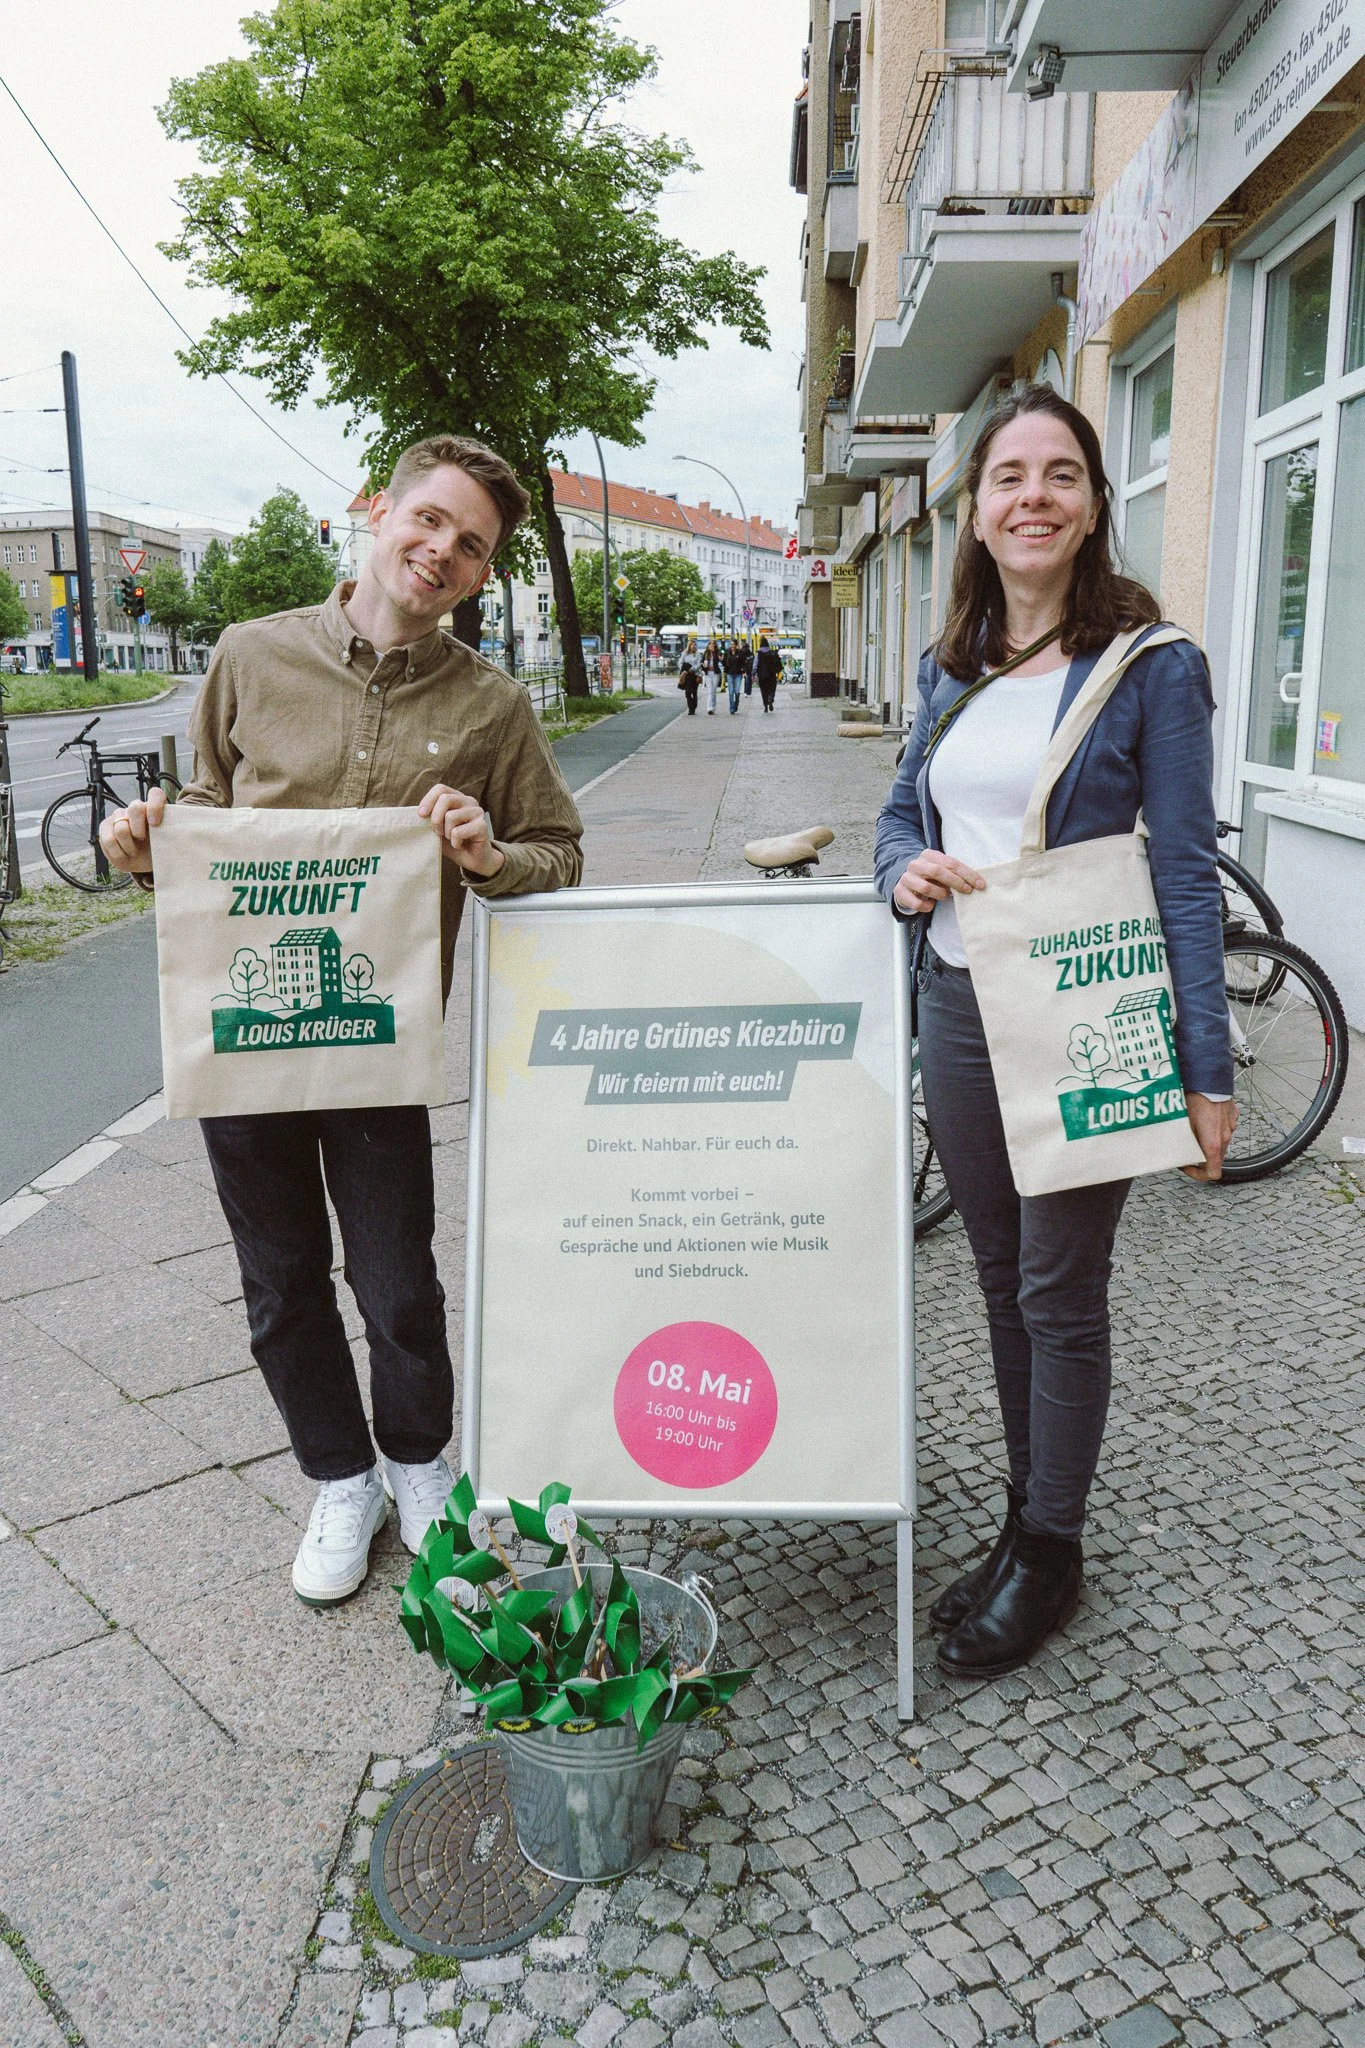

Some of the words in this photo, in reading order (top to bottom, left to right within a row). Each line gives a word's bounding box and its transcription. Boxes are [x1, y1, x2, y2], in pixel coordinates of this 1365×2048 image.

[1216, 0, 1282, 84] Steuerberate
[1234, 109, 1247, 137] fon
[1248, 50, 1292, 118] 45027553
[1299, 26, 1316, 61] fax
[1245, 24, 1351, 157] www.stb-reinhardt.de
[209, 861, 292, 881] ZUHAUSE
[296, 856, 381, 878] BRAUCHT
[228, 881, 367, 917] ZUKUNFT
[1029, 924, 1113, 958] ZUHAUSE
[1119, 917, 1162, 940] BRAU
[236, 1021, 294, 1046] LOUIS
[297, 1015, 377, 1042] KRÜGER
[550, 1024, 567, 1052] 4
[571, 1022, 639, 1051] Jahre
[645, 1020, 730, 1050] Grünes
[736, 1018, 846, 1047] Kiezbüro
[598, 1073, 628, 1094] Wir
[633, 1071, 689, 1093] feiern
[694, 1071, 725, 1092] mit
[729, 1070, 783, 1091] euch!
[1087, 1096, 1149, 1130] LOUIS
[587, 1138, 637, 1153] Direkt.
[642, 1137, 701, 1152] Nahbar.
[706, 1137, 731, 1151] Für
[734, 1137, 771, 1150] euch
[776, 1136, 799, 1150] da.
[631, 1188, 686, 1203] Kommt
[691, 1187, 739, 1201] vorbei
[562, 1214, 587, 1229] auf
[592, 1214, 633, 1228] einen
[638, 1213, 687, 1230] Snack,
[692, 1213, 716, 1227] ein
[720, 1212, 786, 1229] Getränk,
[790, 1213, 825, 1230] gute
[560, 1239, 638, 1258] Gespräche
[643, 1239, 673, 1253] und
[677, 1238, 746, 1253] Aktionen
[751, 1237, 778, 1252] wie
[783, 1236, 829, 1251] Musik
[635, 1264, 664, 1278] und
[668, 1263, 749, 1278] Siebdruck.
[647, 1360, 691, 1393] 08.
[698, 1370, 752, 1404] Mai
[645, 1401, 684, 1421] 16:00
[688, 1409, 713, 1427] Uhr
[717, 1413, 737, 1432] bis
[655, 1426, 694, 1446] 19:00
[697, 1434, 724, 1452] Uhr
